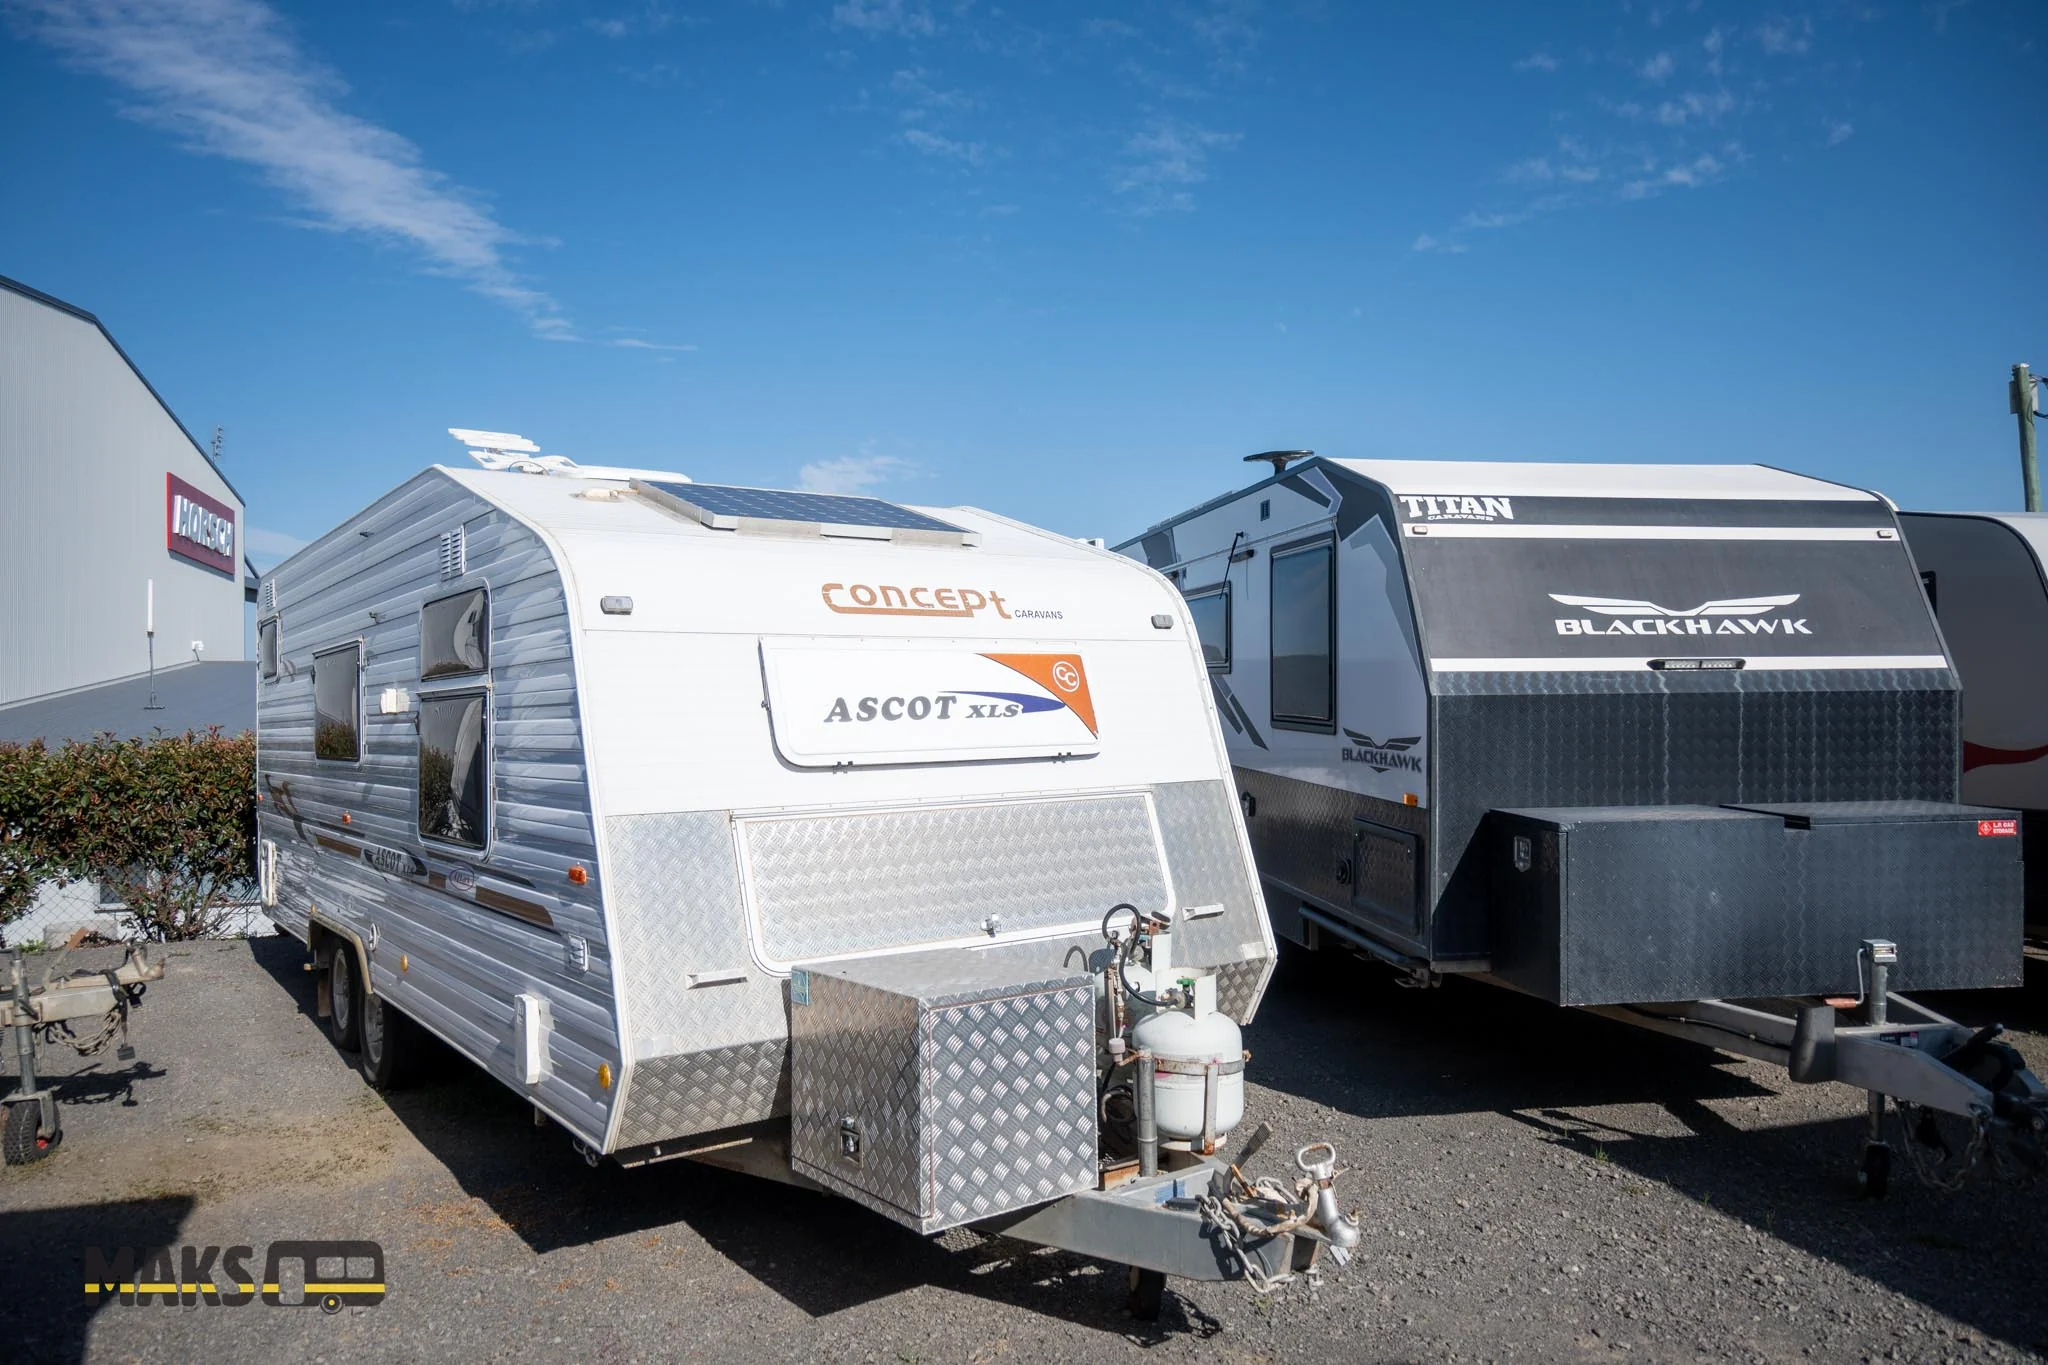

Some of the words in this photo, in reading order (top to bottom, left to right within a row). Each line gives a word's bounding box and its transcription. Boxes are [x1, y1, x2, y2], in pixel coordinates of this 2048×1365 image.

[1399, 495, 1514, 520] TITAN
[173, 495, 233, 557] HORSCH
[1014, 609, 1064, 620] CARAVANS
[1554, 619, 1813, 635] BLACKHAWK
[823, 695, 957, 723] ASCOT
[965, 704, 1022, 718] XLS
[1342, 748, 1422, 773] BLACKHAWK
[374, 847, 402, 873] ASCOT
